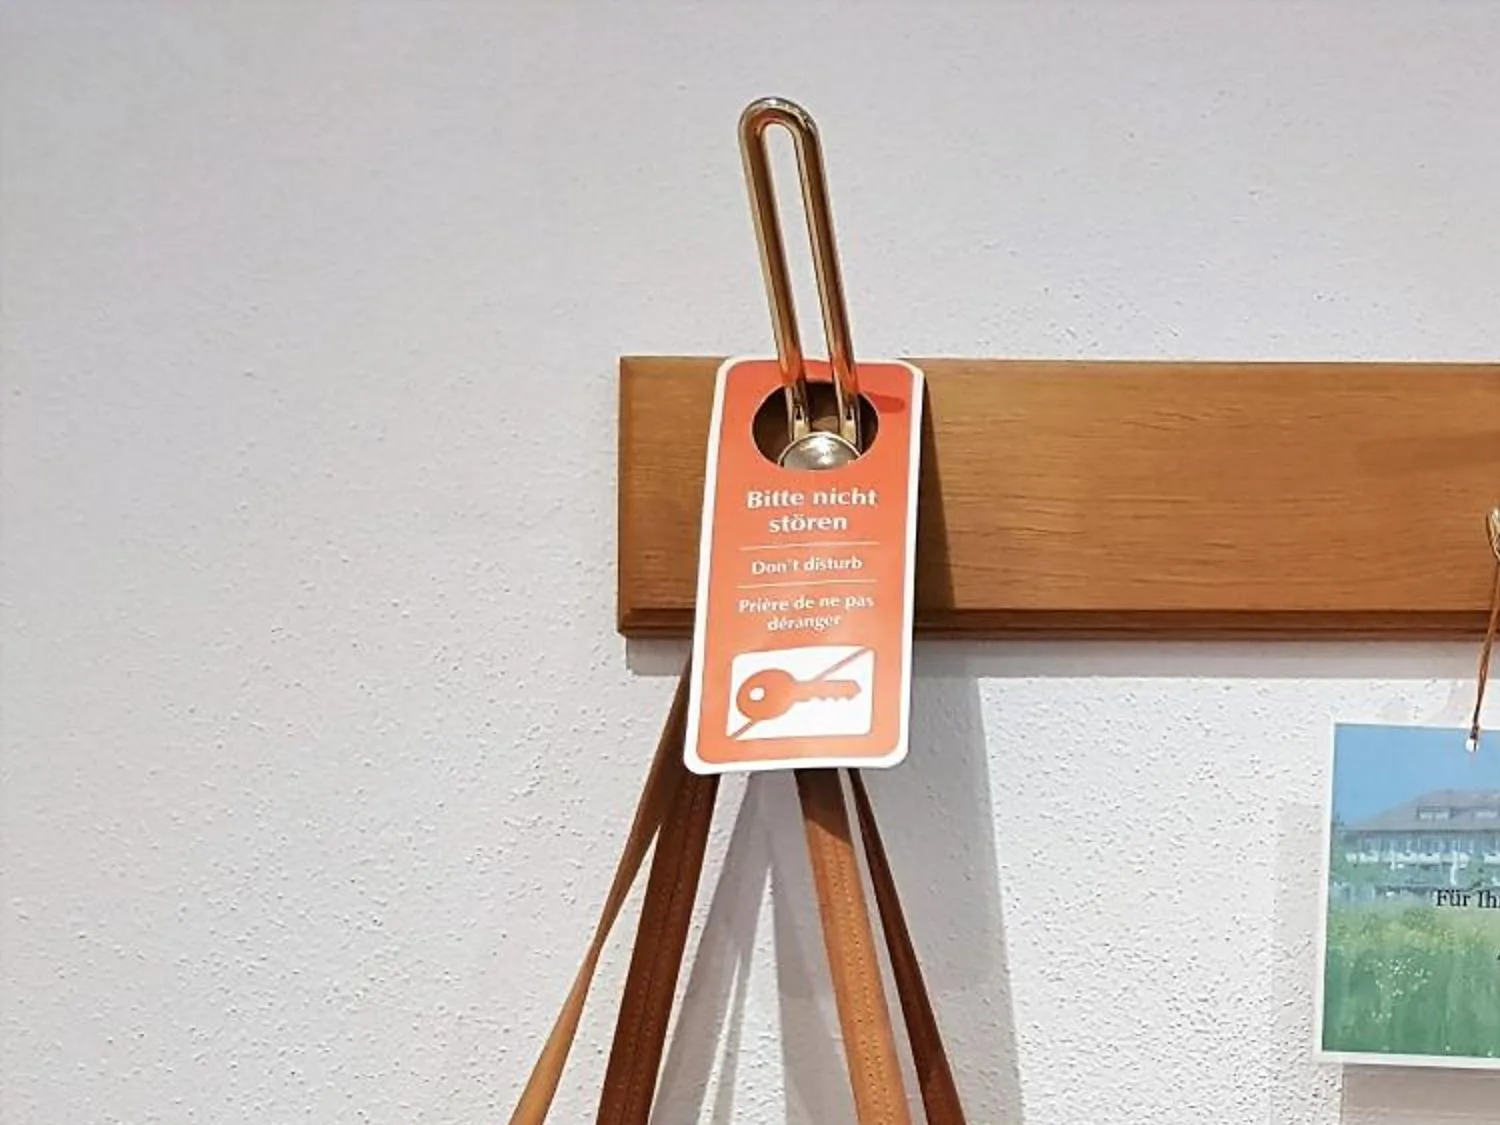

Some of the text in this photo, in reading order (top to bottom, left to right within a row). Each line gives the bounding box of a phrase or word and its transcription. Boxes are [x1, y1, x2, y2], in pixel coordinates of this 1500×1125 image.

[747, 488, 877, 509] Bitte nicht
[769, 513, 847, 533] stören
[803, 555, 863, 572] disturb
[739, 594, 875, 613] Prière de ne pas
[767, 613, 841, 631] déranger
[1436, 889, 1471, 909] Für
